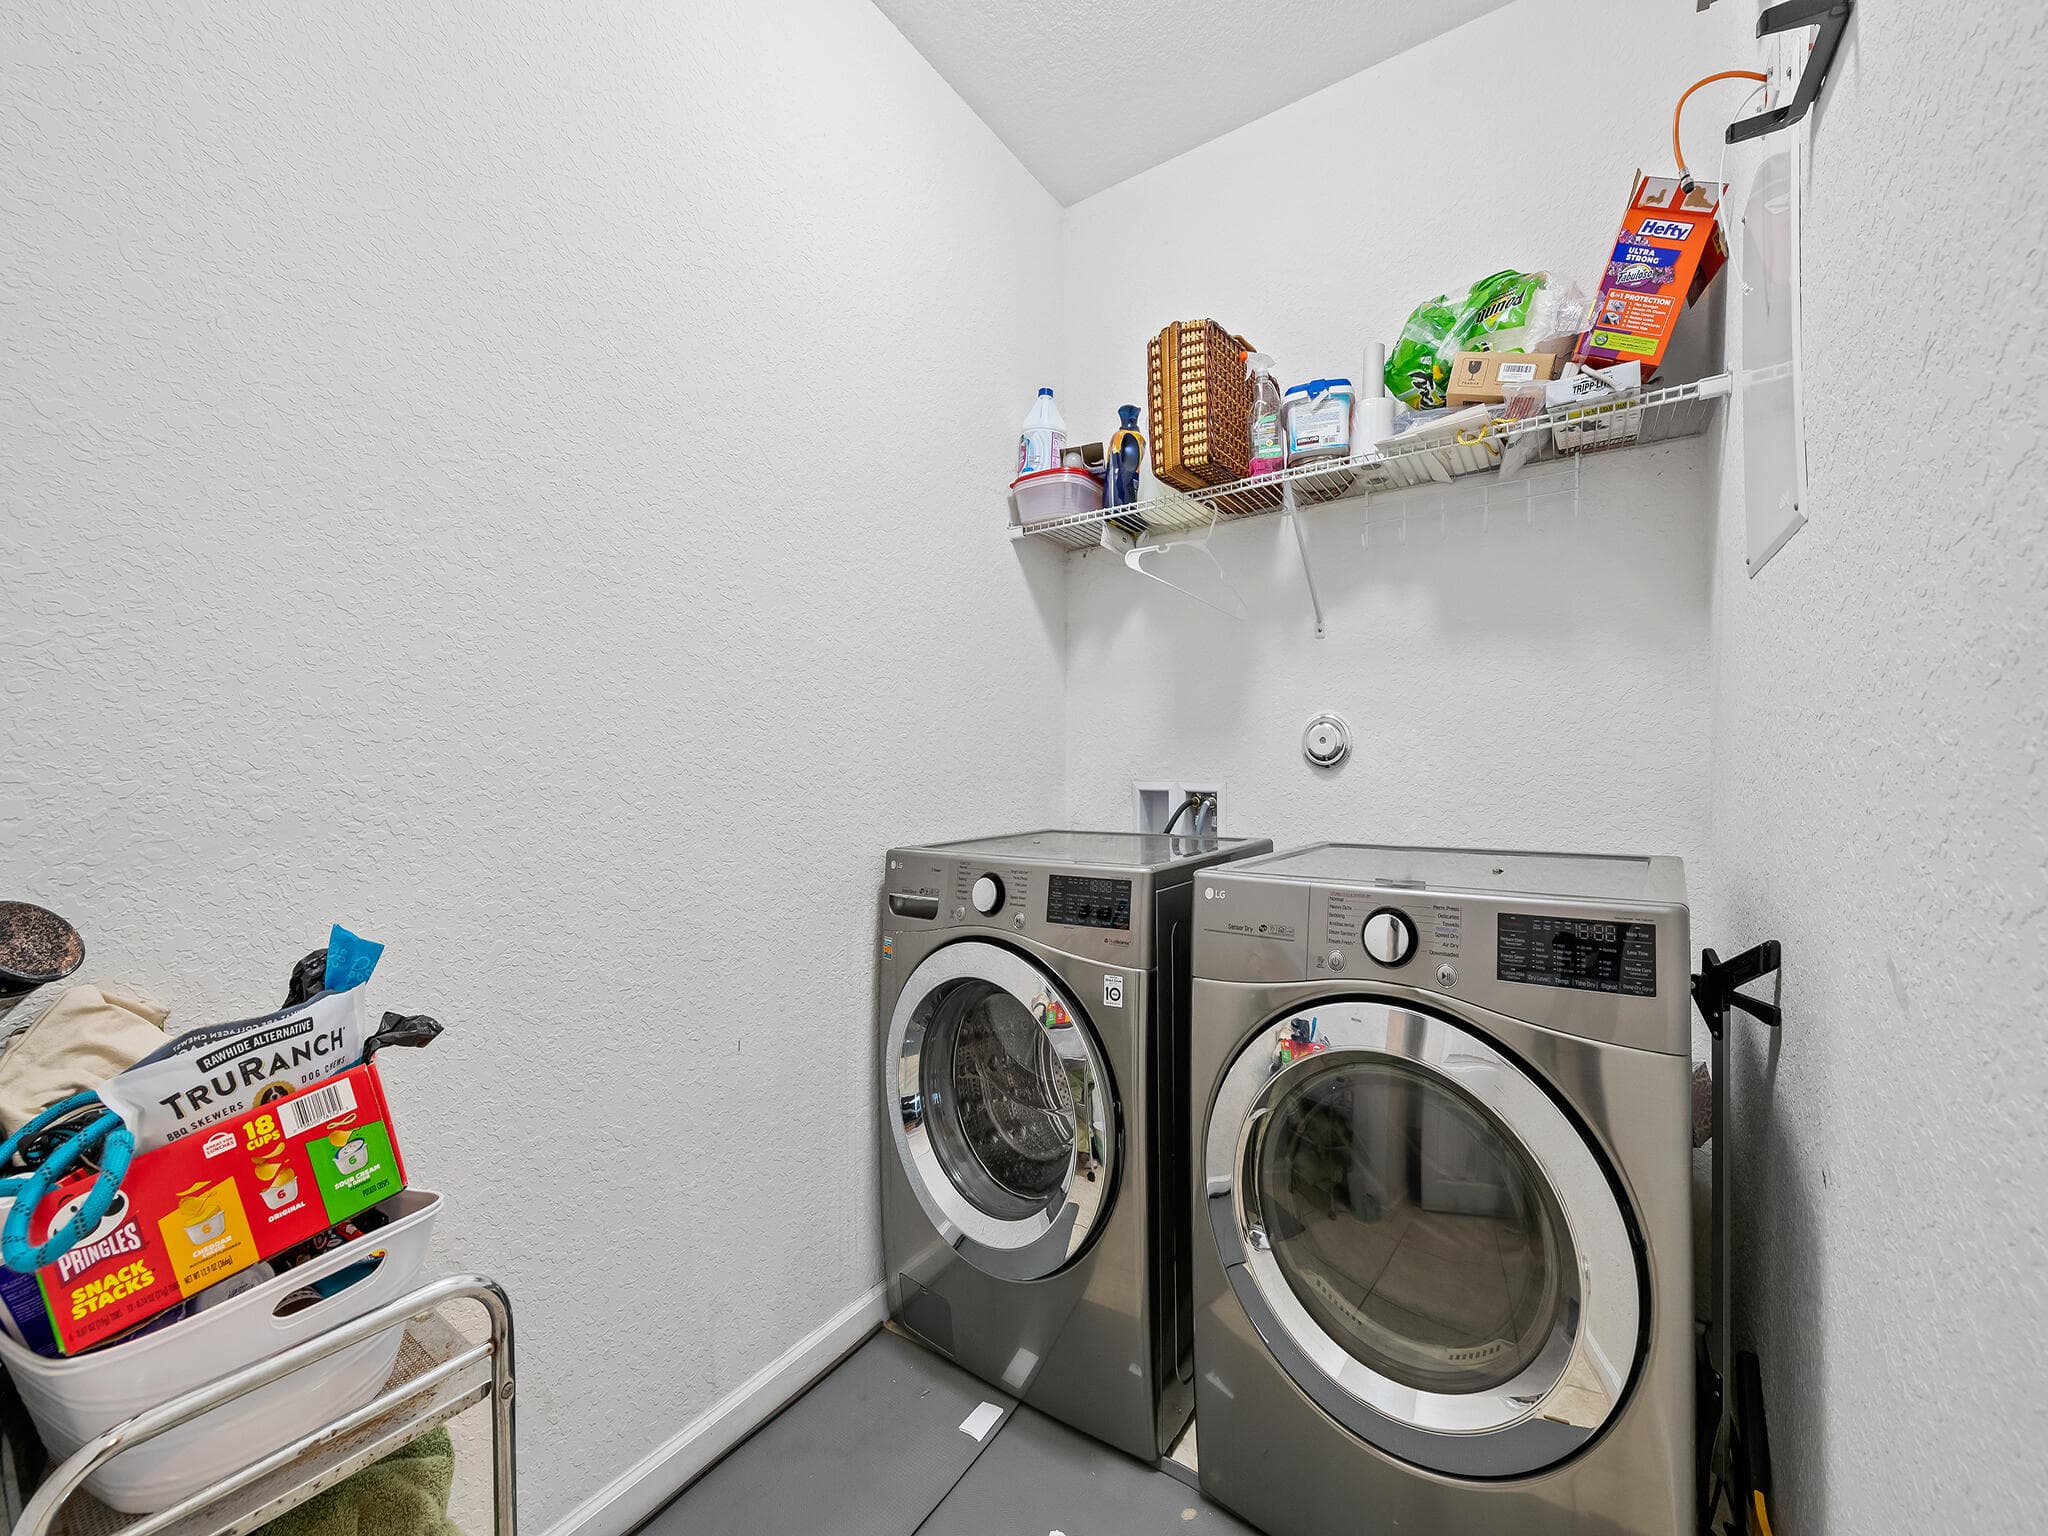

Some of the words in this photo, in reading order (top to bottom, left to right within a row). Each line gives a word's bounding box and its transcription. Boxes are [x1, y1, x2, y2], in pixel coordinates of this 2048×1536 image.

[1641, 220, 1689, 240] Hefty
[1625, 254, 1660, 264] STRONG
[1628, 246, 1655, 257] ULTRA
[1616, 269, 1653, 284] Fabuloso
[1624, 294, 1671, 306] PROTECTION
[1215, 889, 1226, 899] LG
[1227, 923, 1243, 931] Sensor
[1244, 925, 1253, 933] Dry
[1105, 986, 1121, 1001] 10
[203, 1041, 251, 1070] RAWHIDE
[253, 1019, 312, 1048] ALTERNATIVE
[160, 1027, 344, 1121] TRURANCH
[301, 1071, 321, 1084] DOG
[324, 1056, 346, 1074] CHEWS
[166, 1127, 189, 1142] BBQ
[190, 1101, 245, 1131] SKEWERS
[243, 1114, 276, 1141] 18
[246, 1130, 281, 1151] CUPS
[349, 1155, 357, 1165] 6
[334, 1177, 355, 1191] SOUR
[355, 1163, 381, 1181] CREAM
[276, 1189, 286, 1199] 6
[268, 1200, 306, 1223] ORIGINAL
[201, 1224, 212, 1234] 6
[57, 1222, 142, 1282] PRINGLES
[71, 1259, 148, 1305] SNACK
[184, 1273, 193, 1285] NET
[193, 1270, 201, 1281] WT
[71, 1270, 155, 1321] STACKS
